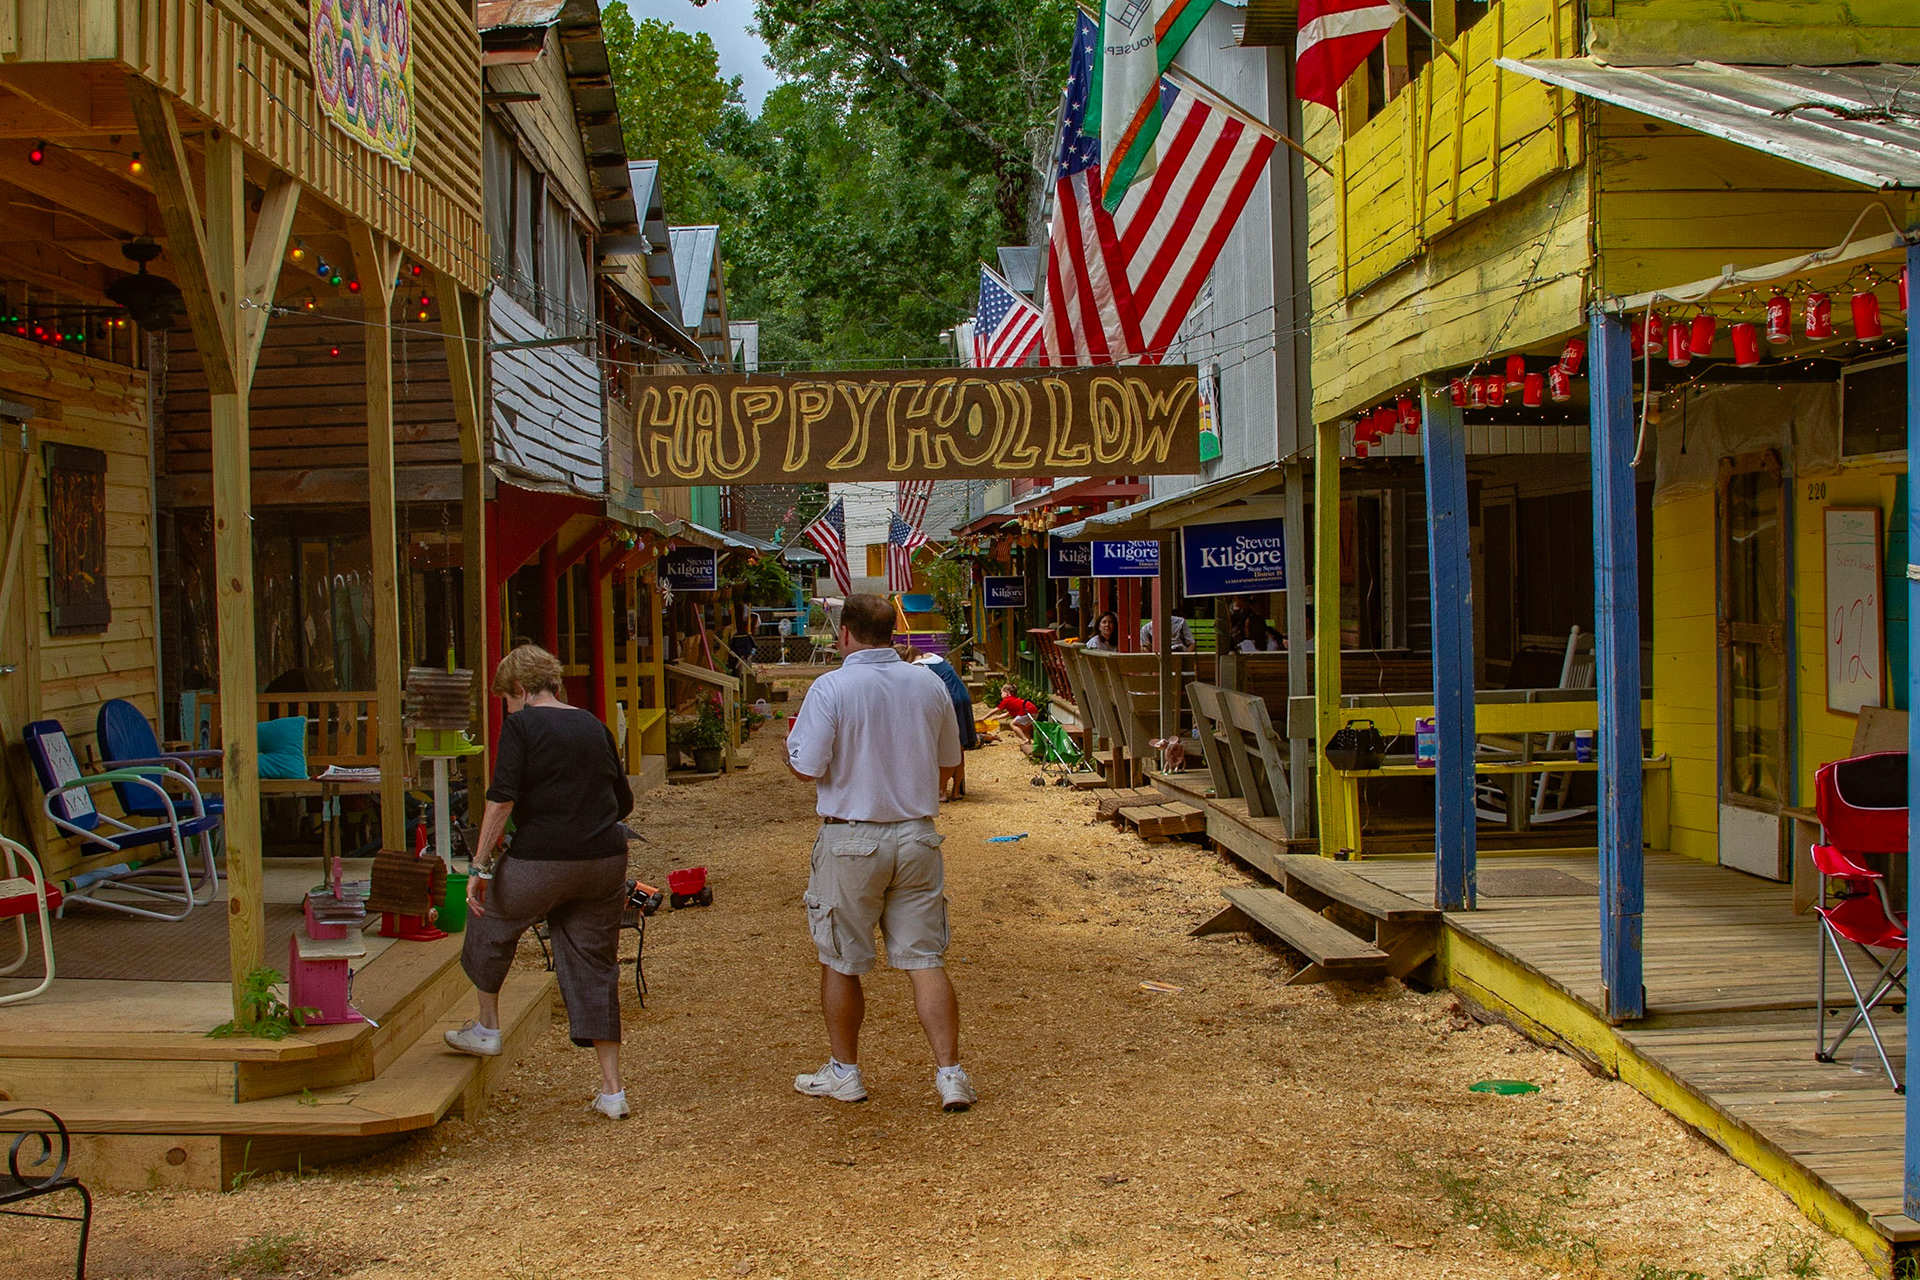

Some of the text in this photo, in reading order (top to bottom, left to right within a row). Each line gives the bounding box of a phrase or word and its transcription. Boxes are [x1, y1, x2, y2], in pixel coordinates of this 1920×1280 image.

[1807, 482, 1826, 501] 220
[1236, 535, 1281, 550] Steven
[1058, 549, 1091, 565] Kilgo
[1103, 543, 1159, 561] Kilgore
[1200, 545, 1282, 571] Kilgore
[686, 557, 713, 566] Steven
[667, 562, 713, 578] Kilgore
[991, 587, 1024, 598] Kilgore
